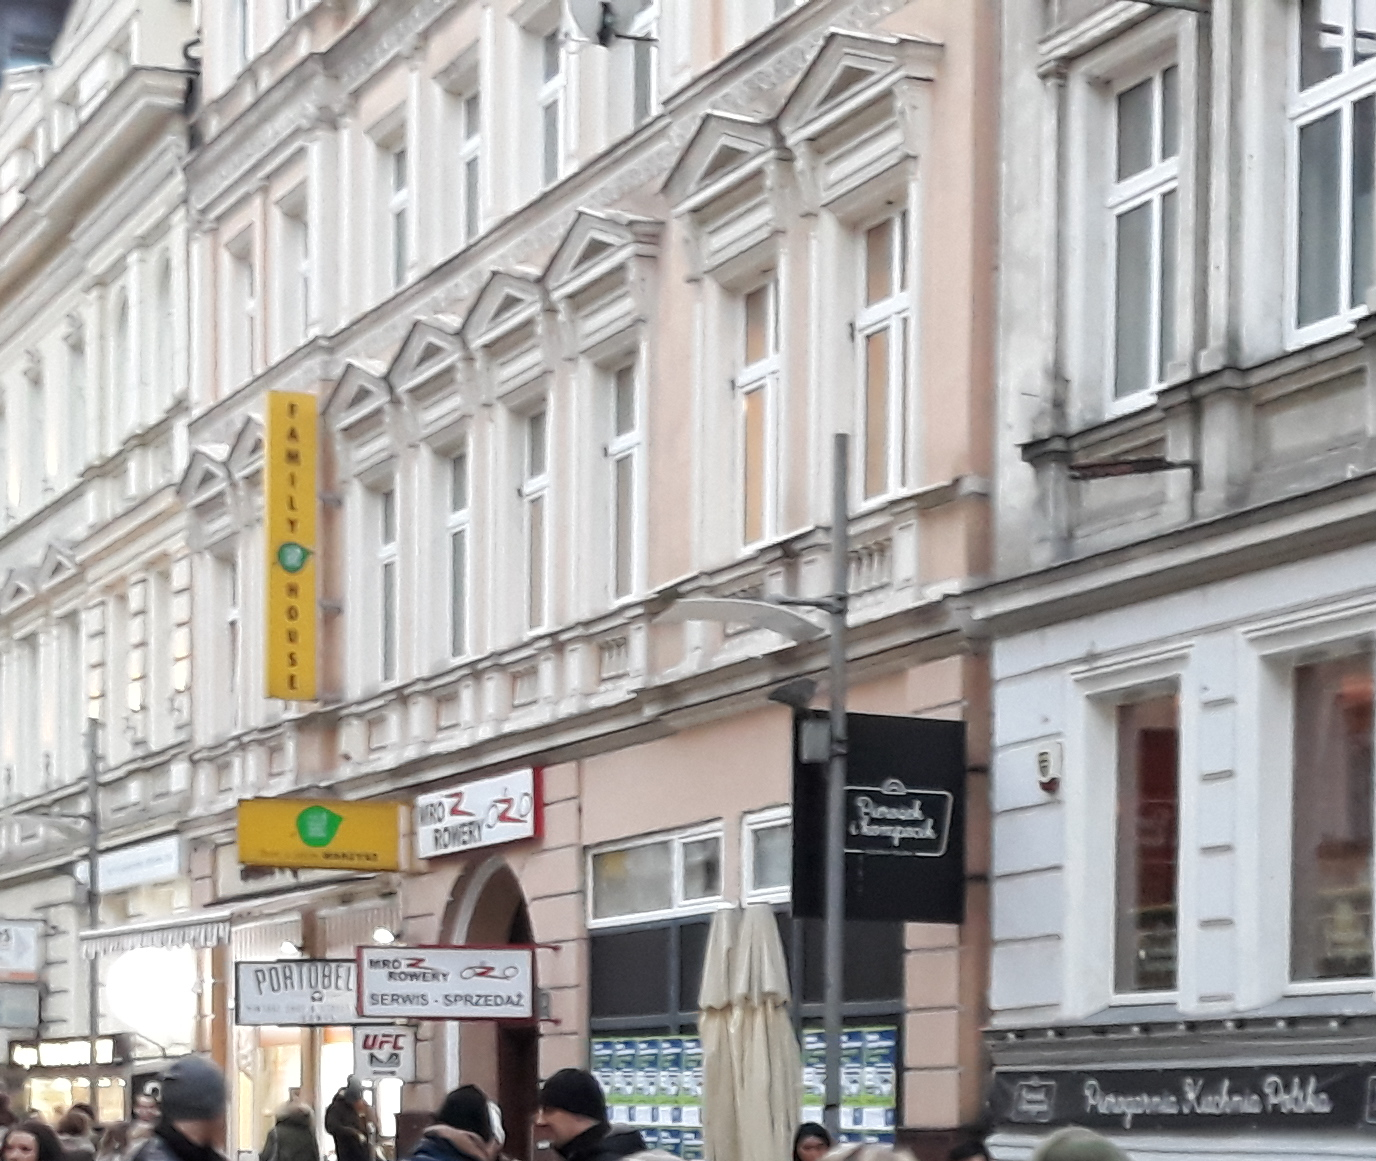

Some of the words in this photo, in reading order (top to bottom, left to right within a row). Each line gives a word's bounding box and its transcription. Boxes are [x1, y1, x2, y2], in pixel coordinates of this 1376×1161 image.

[284, 402, 301, 534] FAMILY
[284, 582, 300, 691] HOUSE
[254, 963, 354, 996] PORTOBEL
[387, 970, 450, 982] ROWERY
[369, 993, 429, 1007] SERWIS
[444, 991, 525, 1007] SPRZEDAŻ
[362, 1033, 406, 1050] UFC
